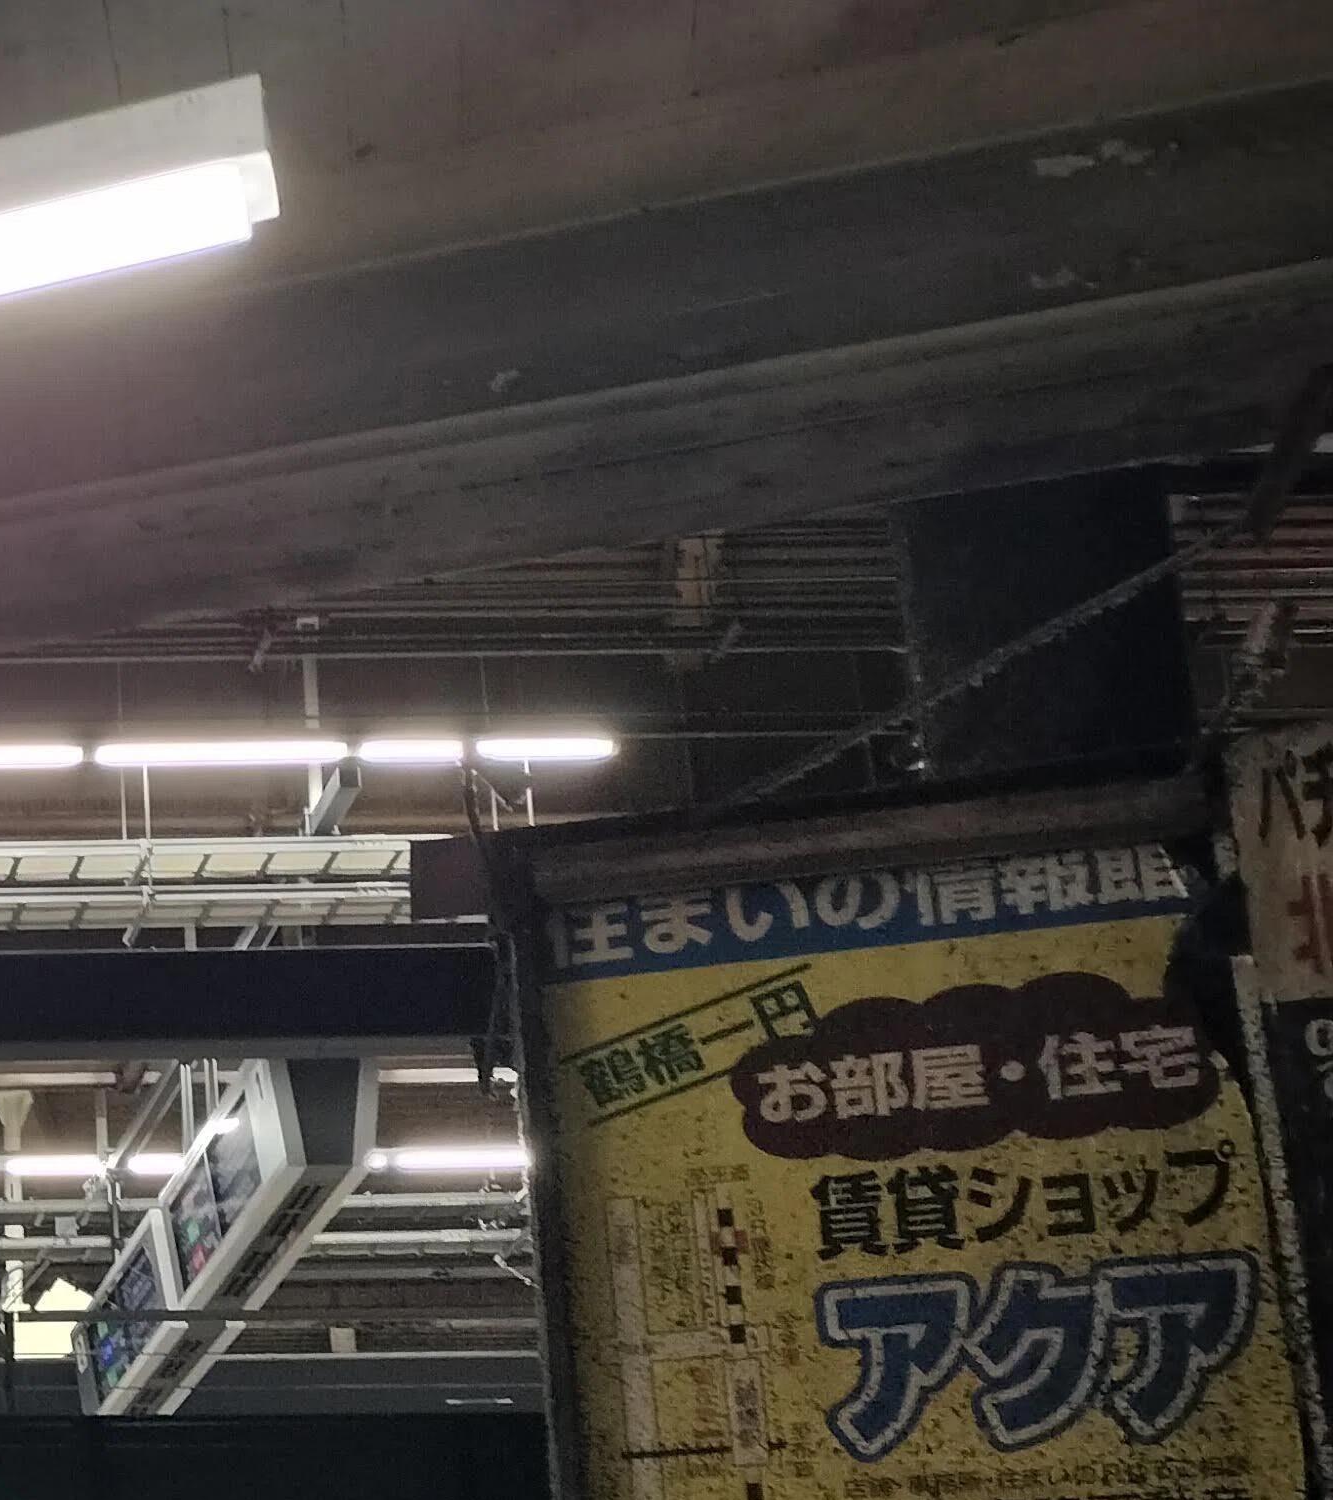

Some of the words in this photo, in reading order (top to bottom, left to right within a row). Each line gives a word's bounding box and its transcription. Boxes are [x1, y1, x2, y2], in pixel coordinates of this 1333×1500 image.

[810, 1141, 1239, 1258] 賃貸ショップ
[813, 1250, 1260, 1463] アクア
